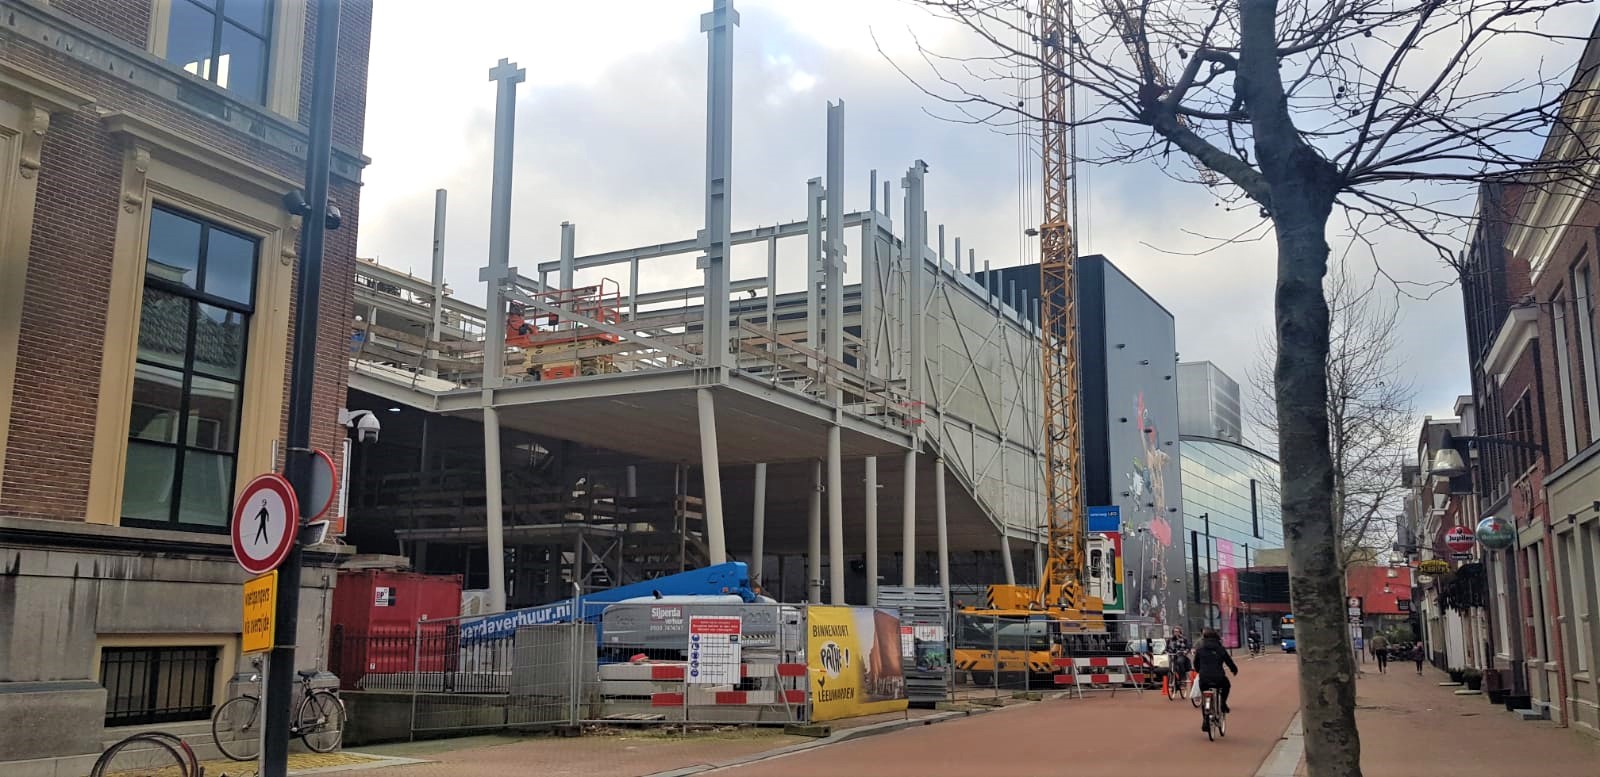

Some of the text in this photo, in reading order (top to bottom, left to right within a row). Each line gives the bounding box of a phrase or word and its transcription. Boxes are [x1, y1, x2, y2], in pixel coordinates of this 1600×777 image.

[1449, 534, 1474, 542] Jupiler
[651, 607, 681, 619] Sijperda
[812, 625, 849, 638] BINNENKORT
[818, 688, 855, 703] LEEUWARDEN
